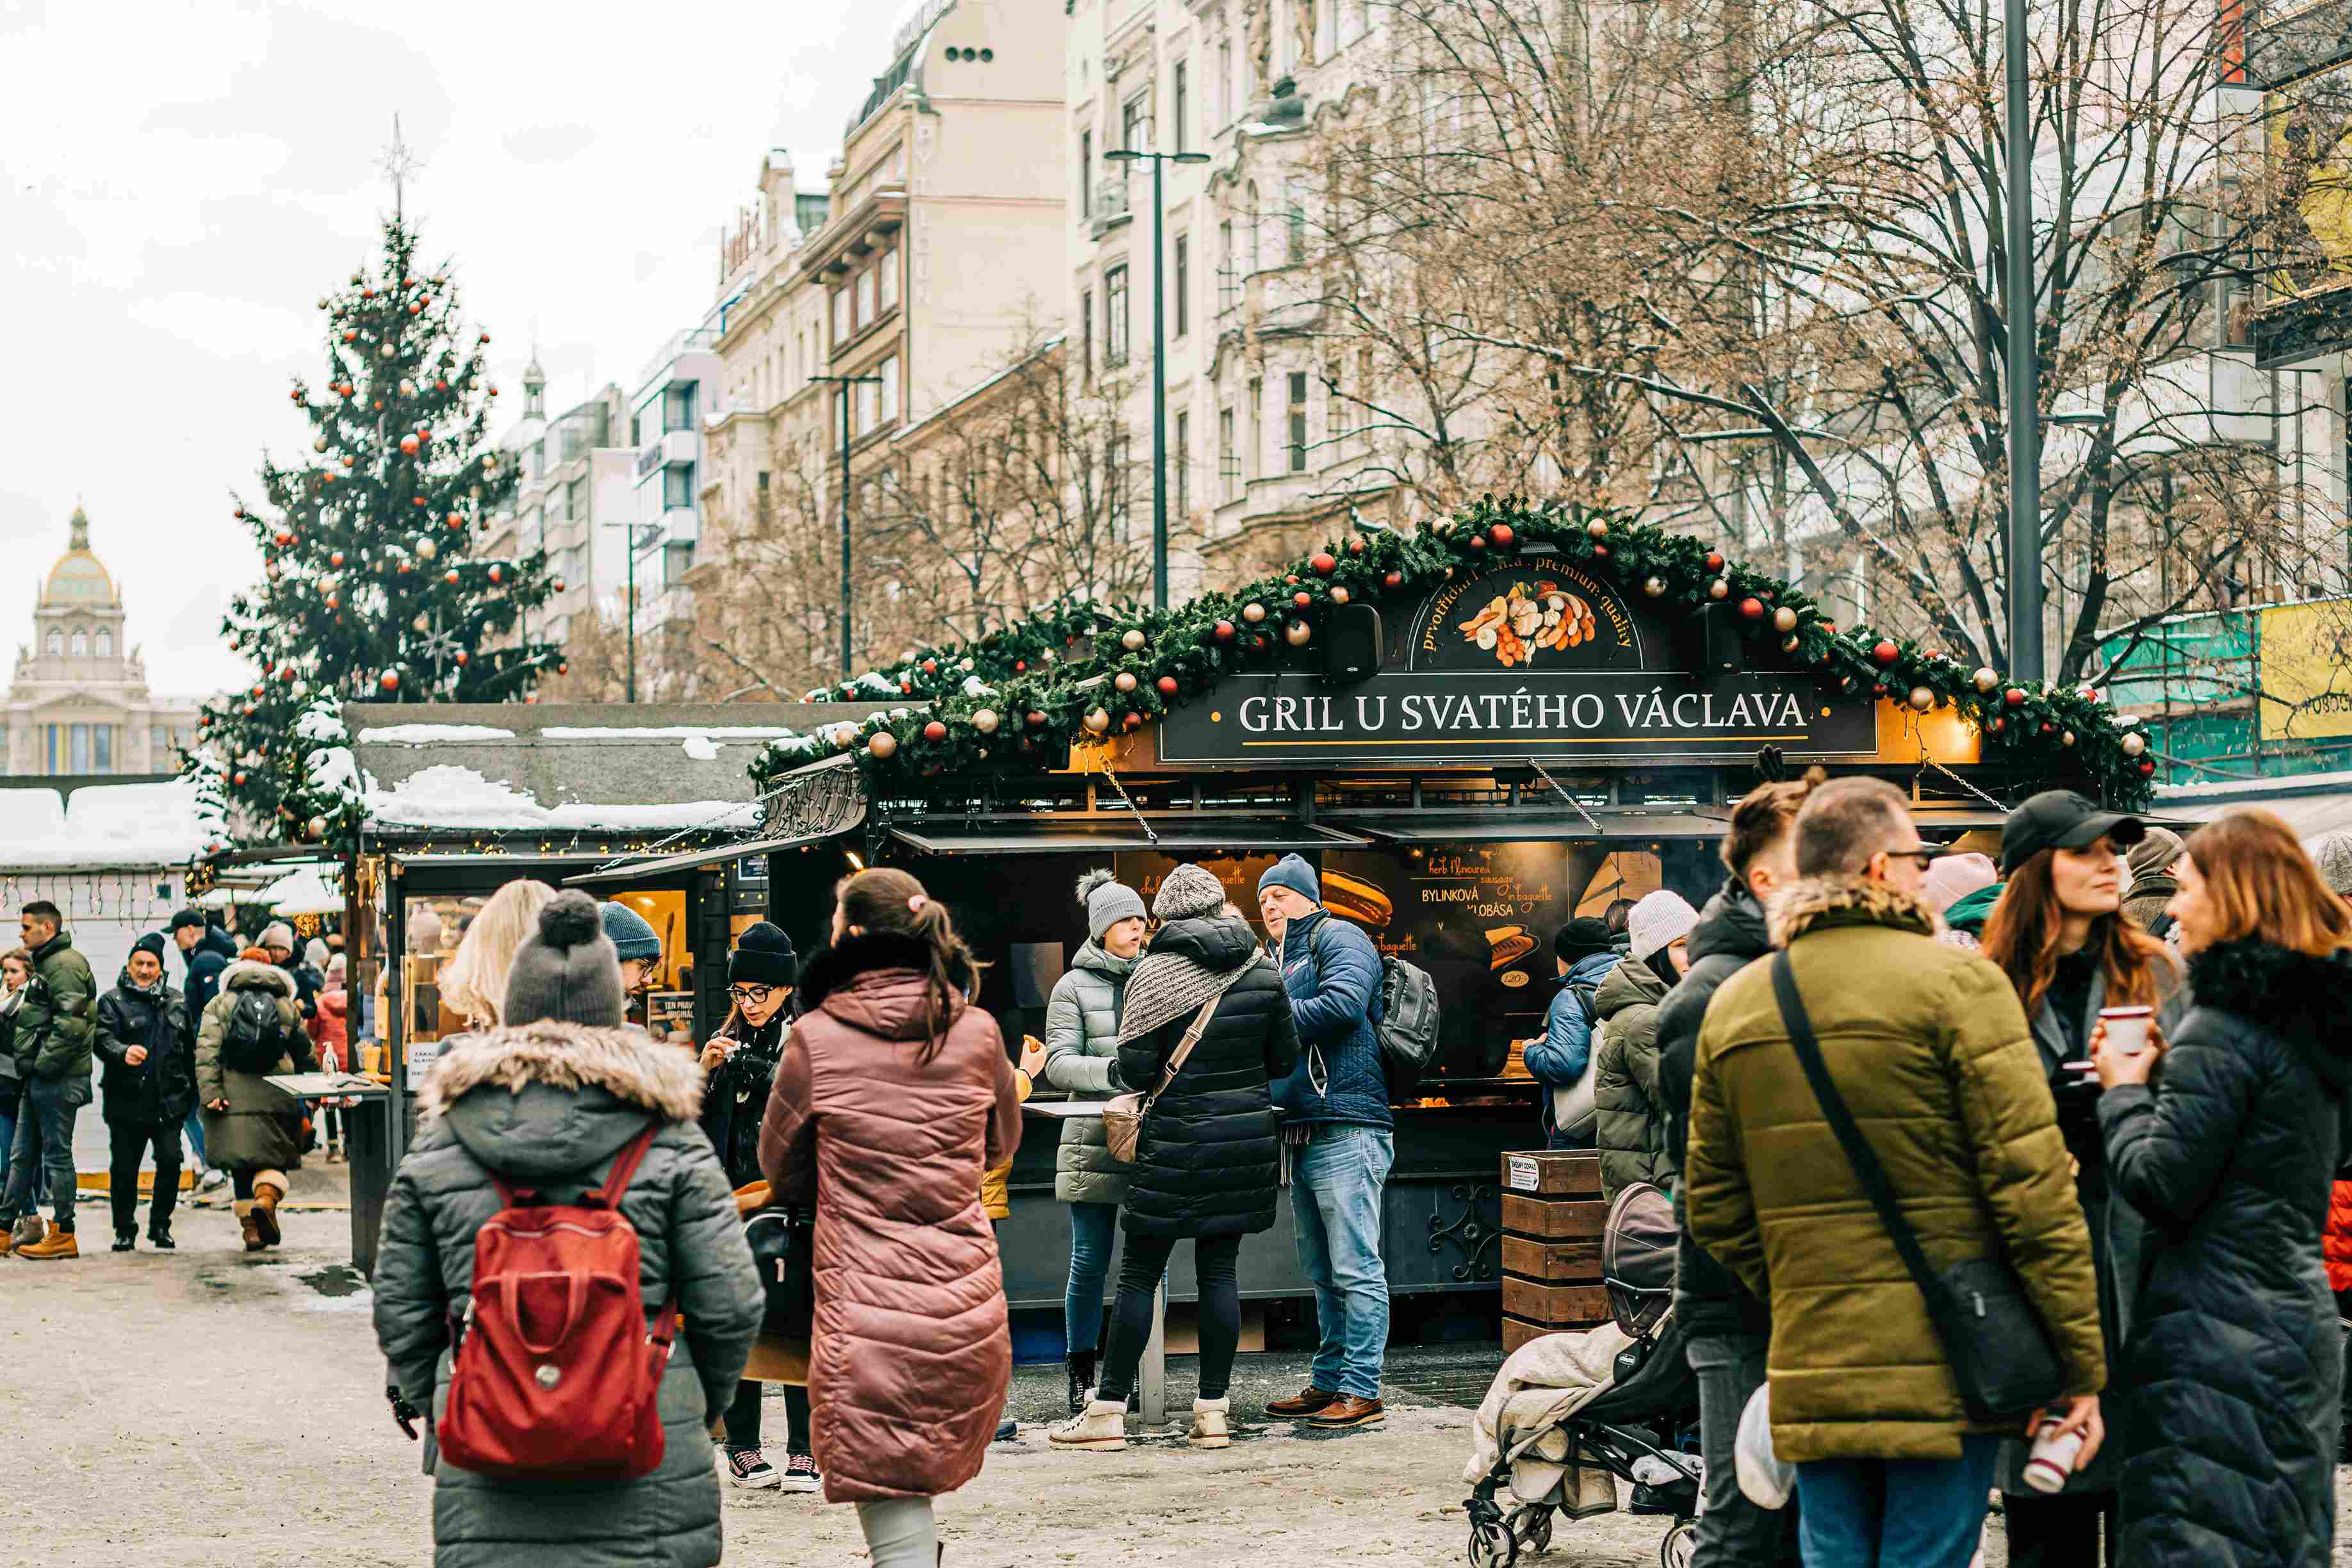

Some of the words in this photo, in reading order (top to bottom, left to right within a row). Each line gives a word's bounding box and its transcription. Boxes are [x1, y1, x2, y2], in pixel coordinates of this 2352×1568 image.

[1535, 558, 1600, 594] premium
[1601, 596, 1632, 647] quality
[1239, 696, 1343, 731] GRIL
[1355, 696, 1387, 731] U
[1401, 687, 1604, 730] SVATÉHO
[1615, 686, 1807, 728] VÁCLAVA
[1430, 856, 1447, 874] herb
[1422, 886, 1479, 902] BYLINKOVÁ
[1515, 881, 1553, 913] baguette
[1376, 933, 1417, 958] baguette
